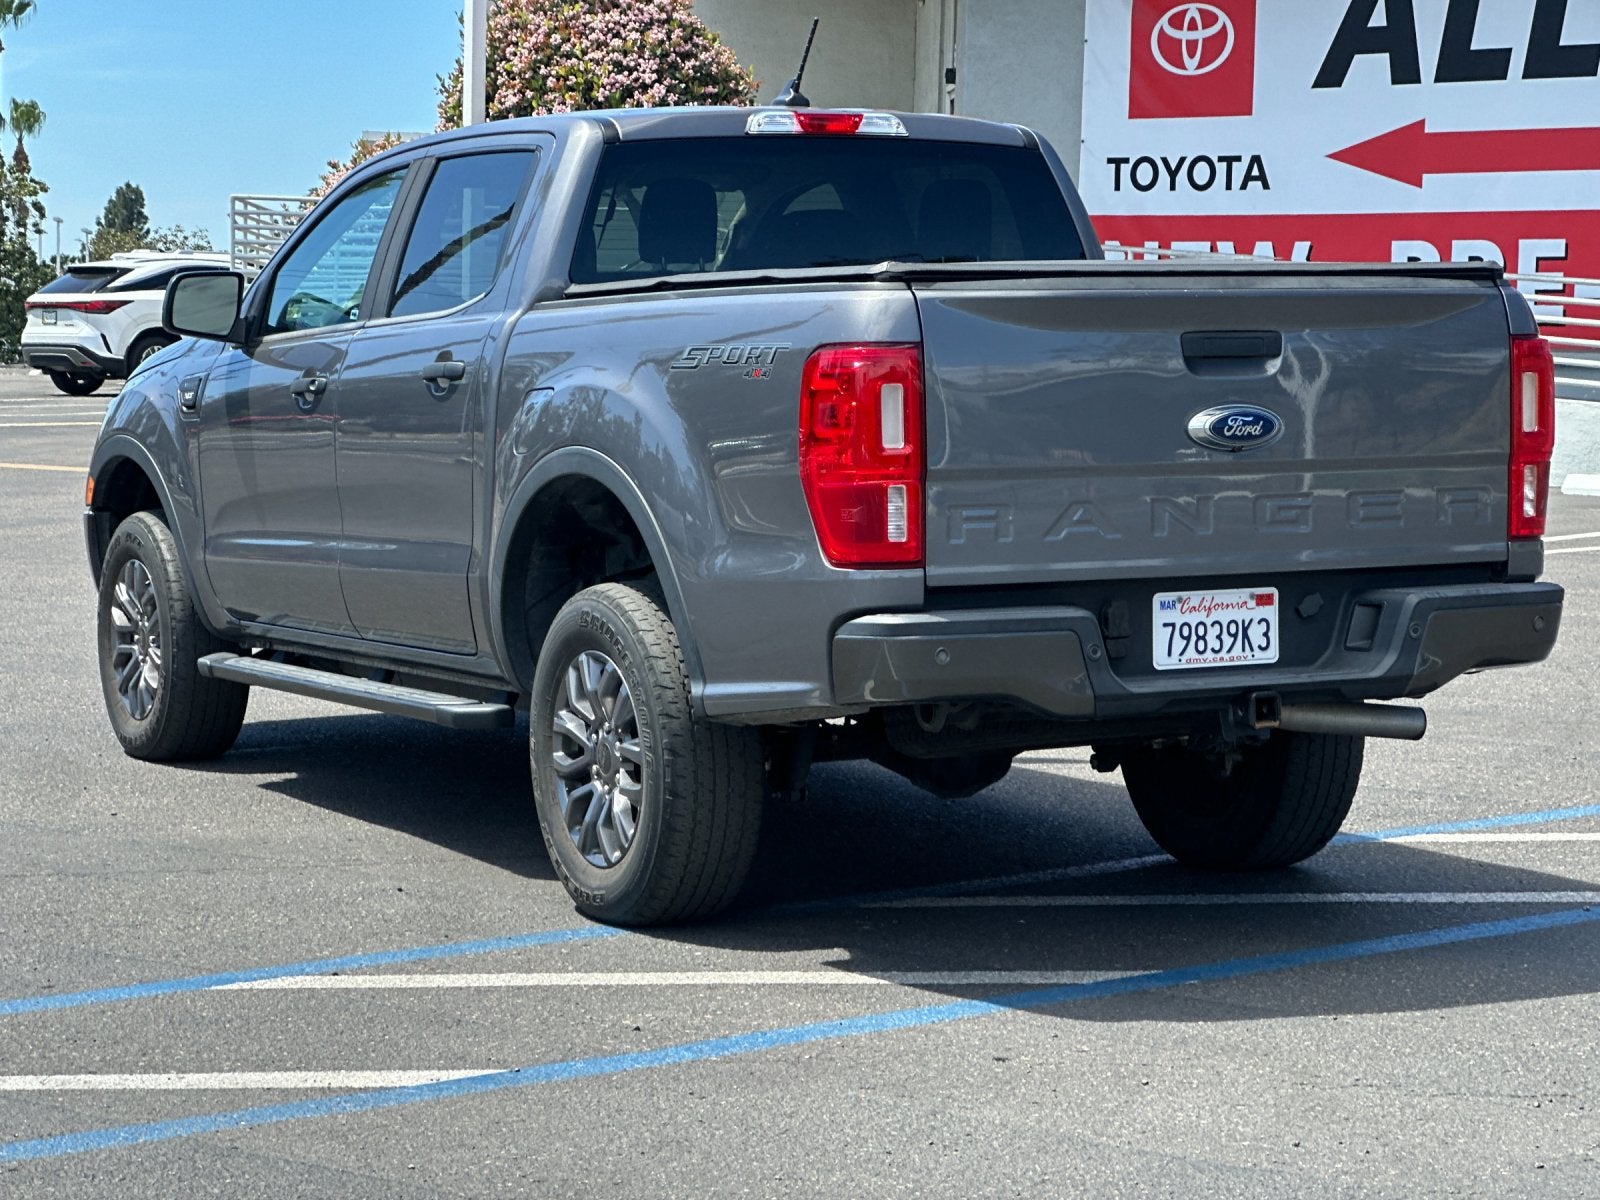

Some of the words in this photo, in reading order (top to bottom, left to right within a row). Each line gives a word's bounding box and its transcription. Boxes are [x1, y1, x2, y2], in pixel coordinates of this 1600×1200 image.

[1311, 0, 1600, 89] ALL
[1107, 155, 1271, 192] TOYOTA
[670, 342, 792, 371] SPORT
[1224, 415, 1264, 437] Ford
[945, 484, 1496, 546] RANGER
[1159, 599, 1177, 611] MAR
[1179, 596, 1256, 619] California
[1162, 617, 1271, 658] 79839K3
[1185, 654, 1249, 665] dmv.ca.gov
